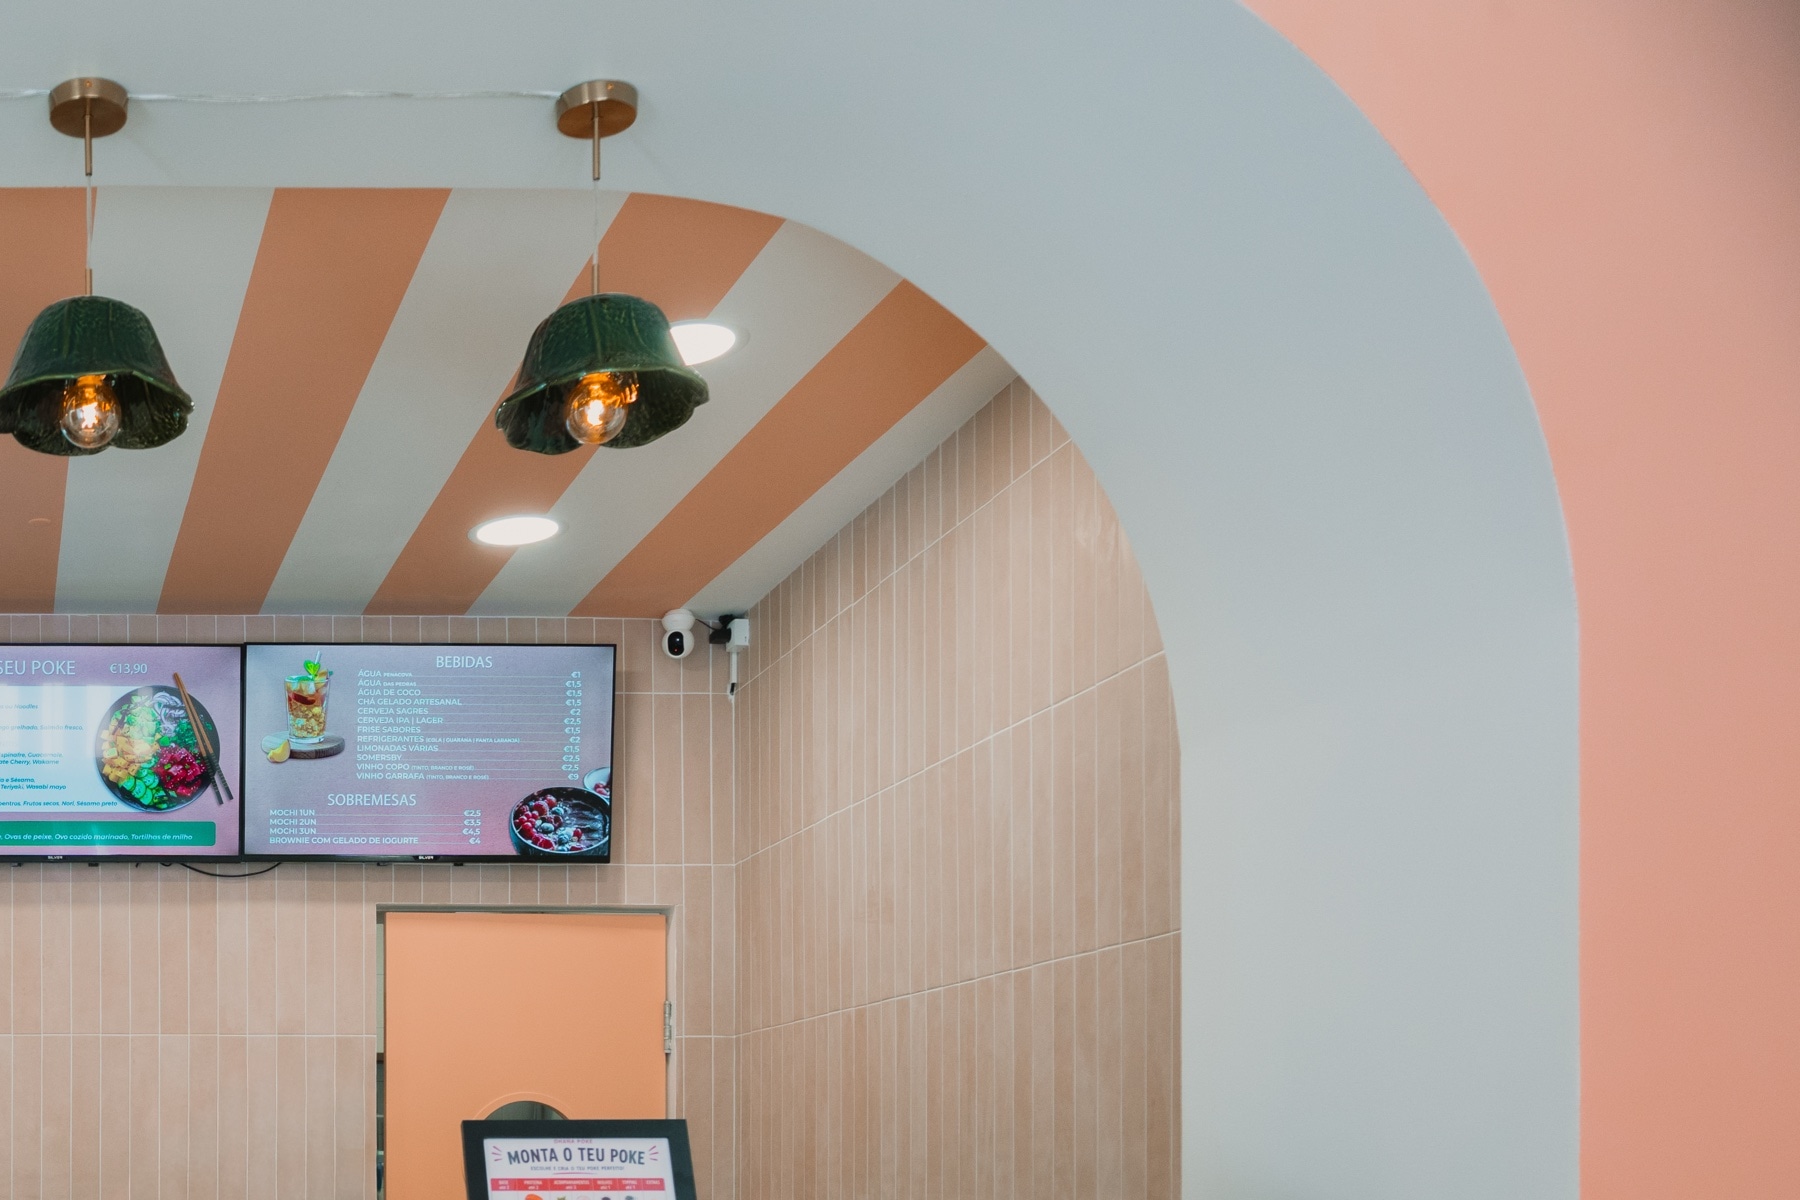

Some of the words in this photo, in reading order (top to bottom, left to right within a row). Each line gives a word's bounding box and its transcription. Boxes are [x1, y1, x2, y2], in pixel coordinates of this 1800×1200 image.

[436, 656, 493, 668] BEBIDAS
[32, 660, 75, 675] POKE
[110, 663, 148, 675] €13,90
[358, 669, 381, 677] ÁGUA
[358, 678, 381, 687] ÁGUA
[358, 688, 381, 696] ÁGUA
[358, 697, 375, 705] CHÁ
[409, 743, 438, 752] VÁRIAS
[327, 793, 417, 806] SOBREMESAS
[270, 818, 297, 826] MOCHI
[299, 818, 316, 826] 2UN
[463, 819, 481, 827] €3,5
[462, 828, 481, 836] €4,5
[507, 1148, 558, 1165] MONTA
[563, 1147, 572, 1161] O
[578, 1148, 605, 1162] TEU
[610, 1149, 645, 1165] POKE
